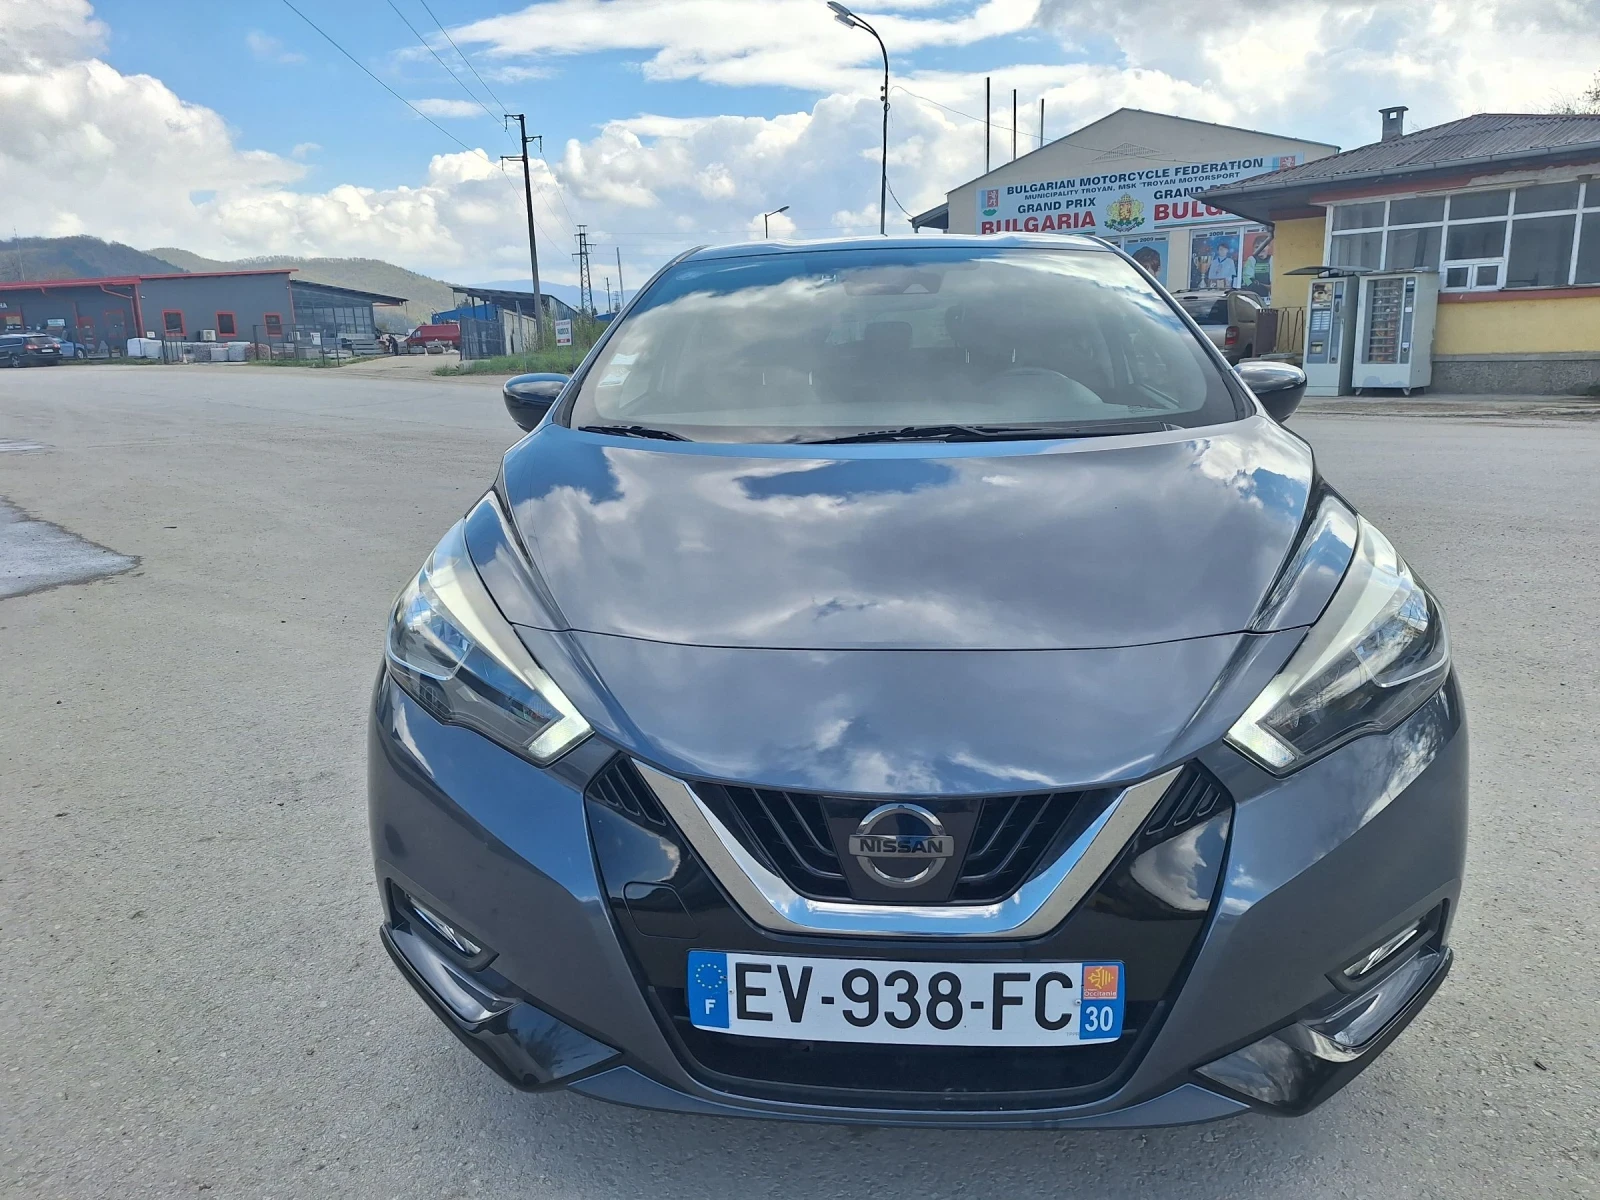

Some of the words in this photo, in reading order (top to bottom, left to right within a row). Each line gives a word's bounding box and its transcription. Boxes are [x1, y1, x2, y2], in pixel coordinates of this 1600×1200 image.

[1007, 179, 1075, 195] BULGARIAN
[1080, 168, 1170, 187] MOTORCYCLE
[1174, 158, 1264, 177] FEDERATION
[1024, 190, 1079, 200] MUNICIPALITY
[1081, 186, 1116, 194] TROYAN,
[1178, 172, 1240, 184] MOTORSPORT
[1018, 201, 1062, 214] GRAND
[1066, 197, 1096, 209] PRIX
[1154, 200, 1230, 221] BULG
[981, 210, 1096, 235] BULGARIA
[860, 839, 943, 853] NISSAN
[704, 999, 716, 1015] F
[735, 962, 1073, 1031] EV-938-FC
[1084, 1006, 1114, 1032] 30
